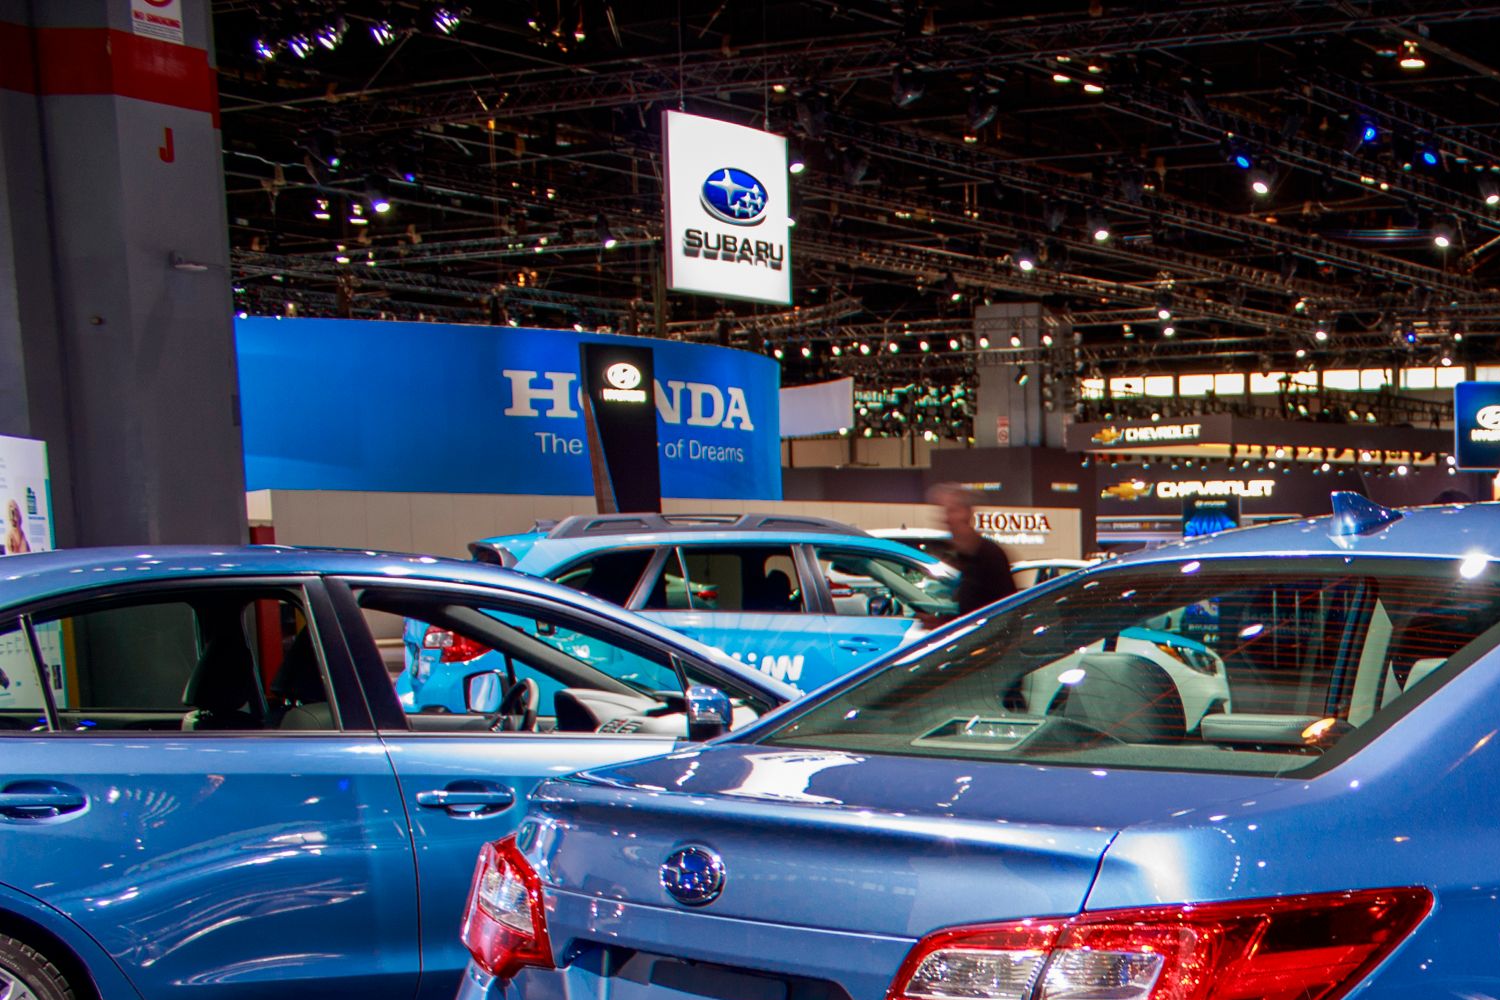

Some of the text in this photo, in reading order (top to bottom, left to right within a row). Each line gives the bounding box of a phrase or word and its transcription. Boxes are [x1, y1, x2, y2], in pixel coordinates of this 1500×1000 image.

[159, 127, 175, 164] J
[684, 228, 784, 265] SUBARU
[502, 369, 755, 431] HNDA
[535, 431, 745, 463] The of Dreams
[1125, 424, 1200, 442] CHEVROLET
[1156, 480, 1275, 498] CHEVROLET
[975, 512, 1051, 532] HONDA
